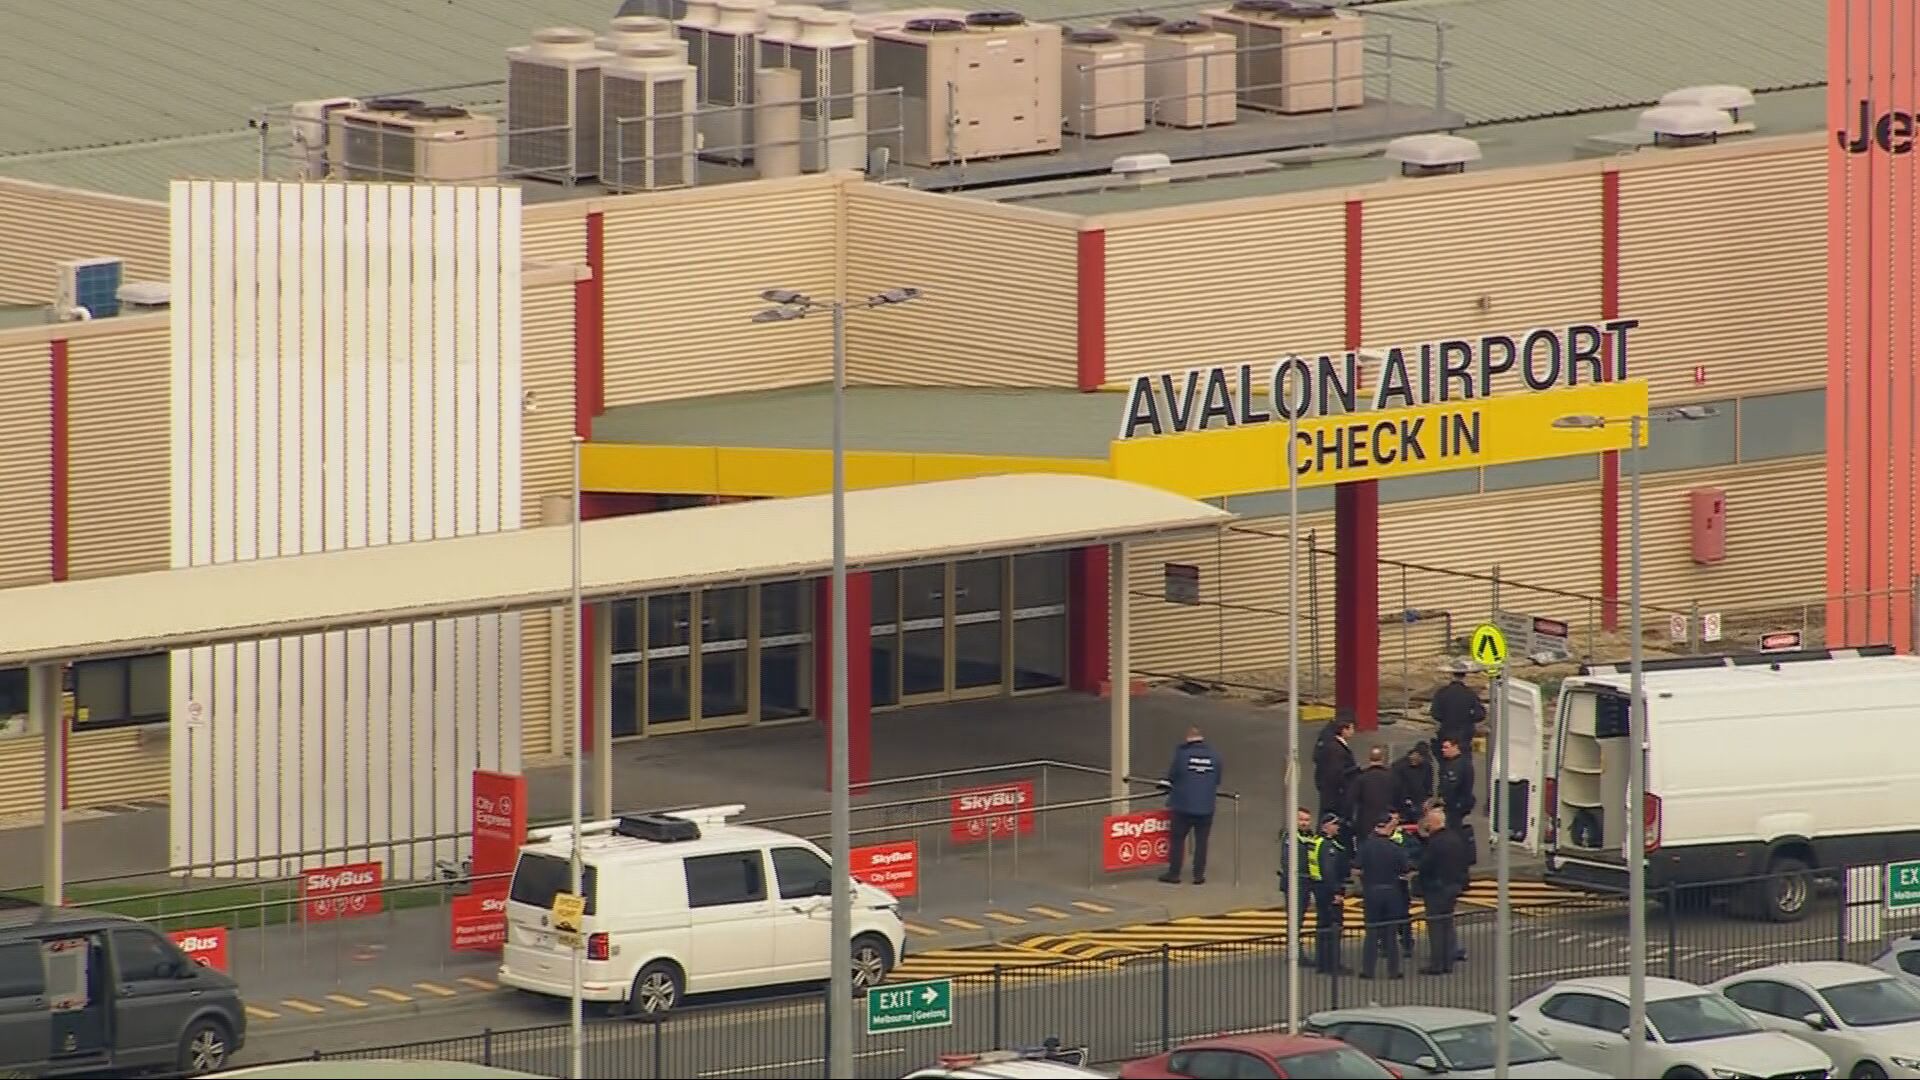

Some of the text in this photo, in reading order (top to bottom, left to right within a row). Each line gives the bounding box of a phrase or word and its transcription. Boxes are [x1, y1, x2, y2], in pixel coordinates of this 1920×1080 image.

[1837, 99, 1920, 155] Je
[1121, 319, 1639, 439] AVALON AIRPORT
[1289, 411, 1480, 474] CHECK IN
[476, 797, 495, 813] City
[960, 791, 1026, 811] SkyBus
[306, 871, 374, 892] SkyBus
[1900, 867, 1920, 886] EX
[481, 898, 506, 912] Sky
[880, 989, 915, 1010] EXIT
[873, 1009, 947, 1025] Melbourne Geelong
